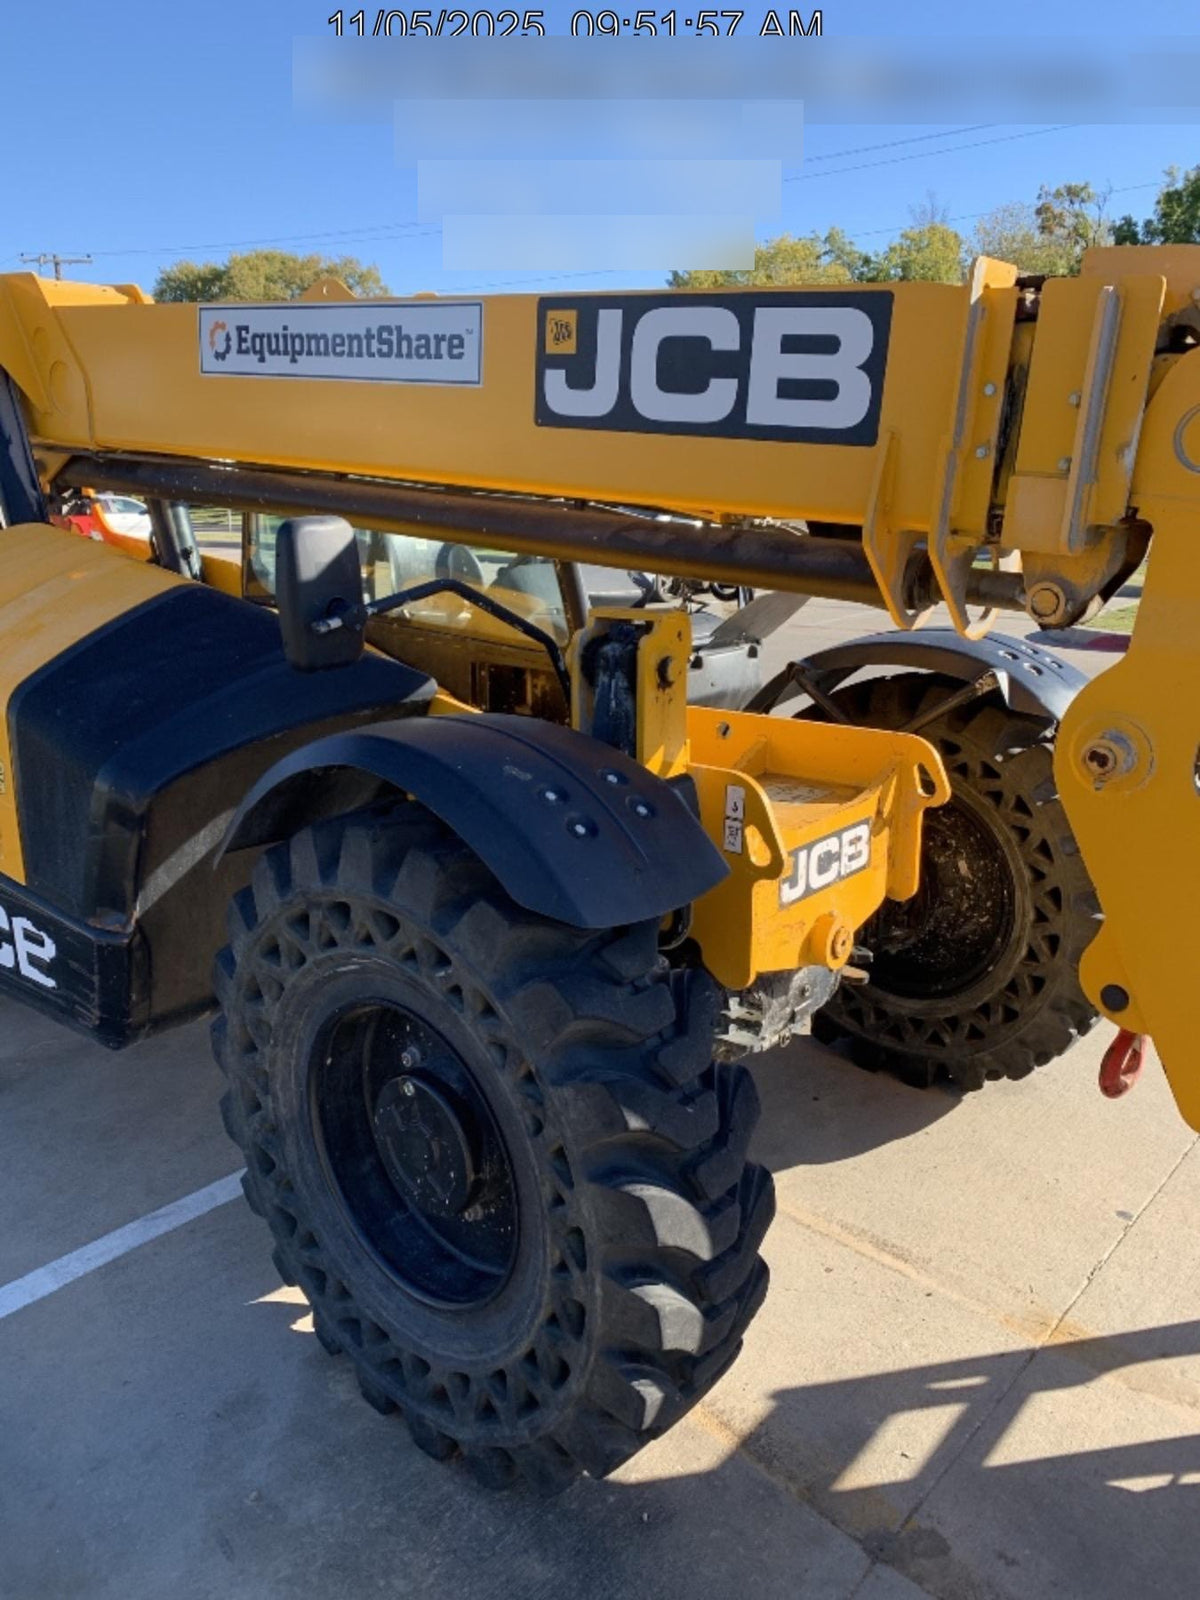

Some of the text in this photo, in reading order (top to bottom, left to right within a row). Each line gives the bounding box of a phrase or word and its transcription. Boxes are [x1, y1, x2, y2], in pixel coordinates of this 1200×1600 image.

[235, 325, 465, 363] EquipmentShare
[544, 306, 874, 429] JCB
[781, 824, 870, 904] JCB
